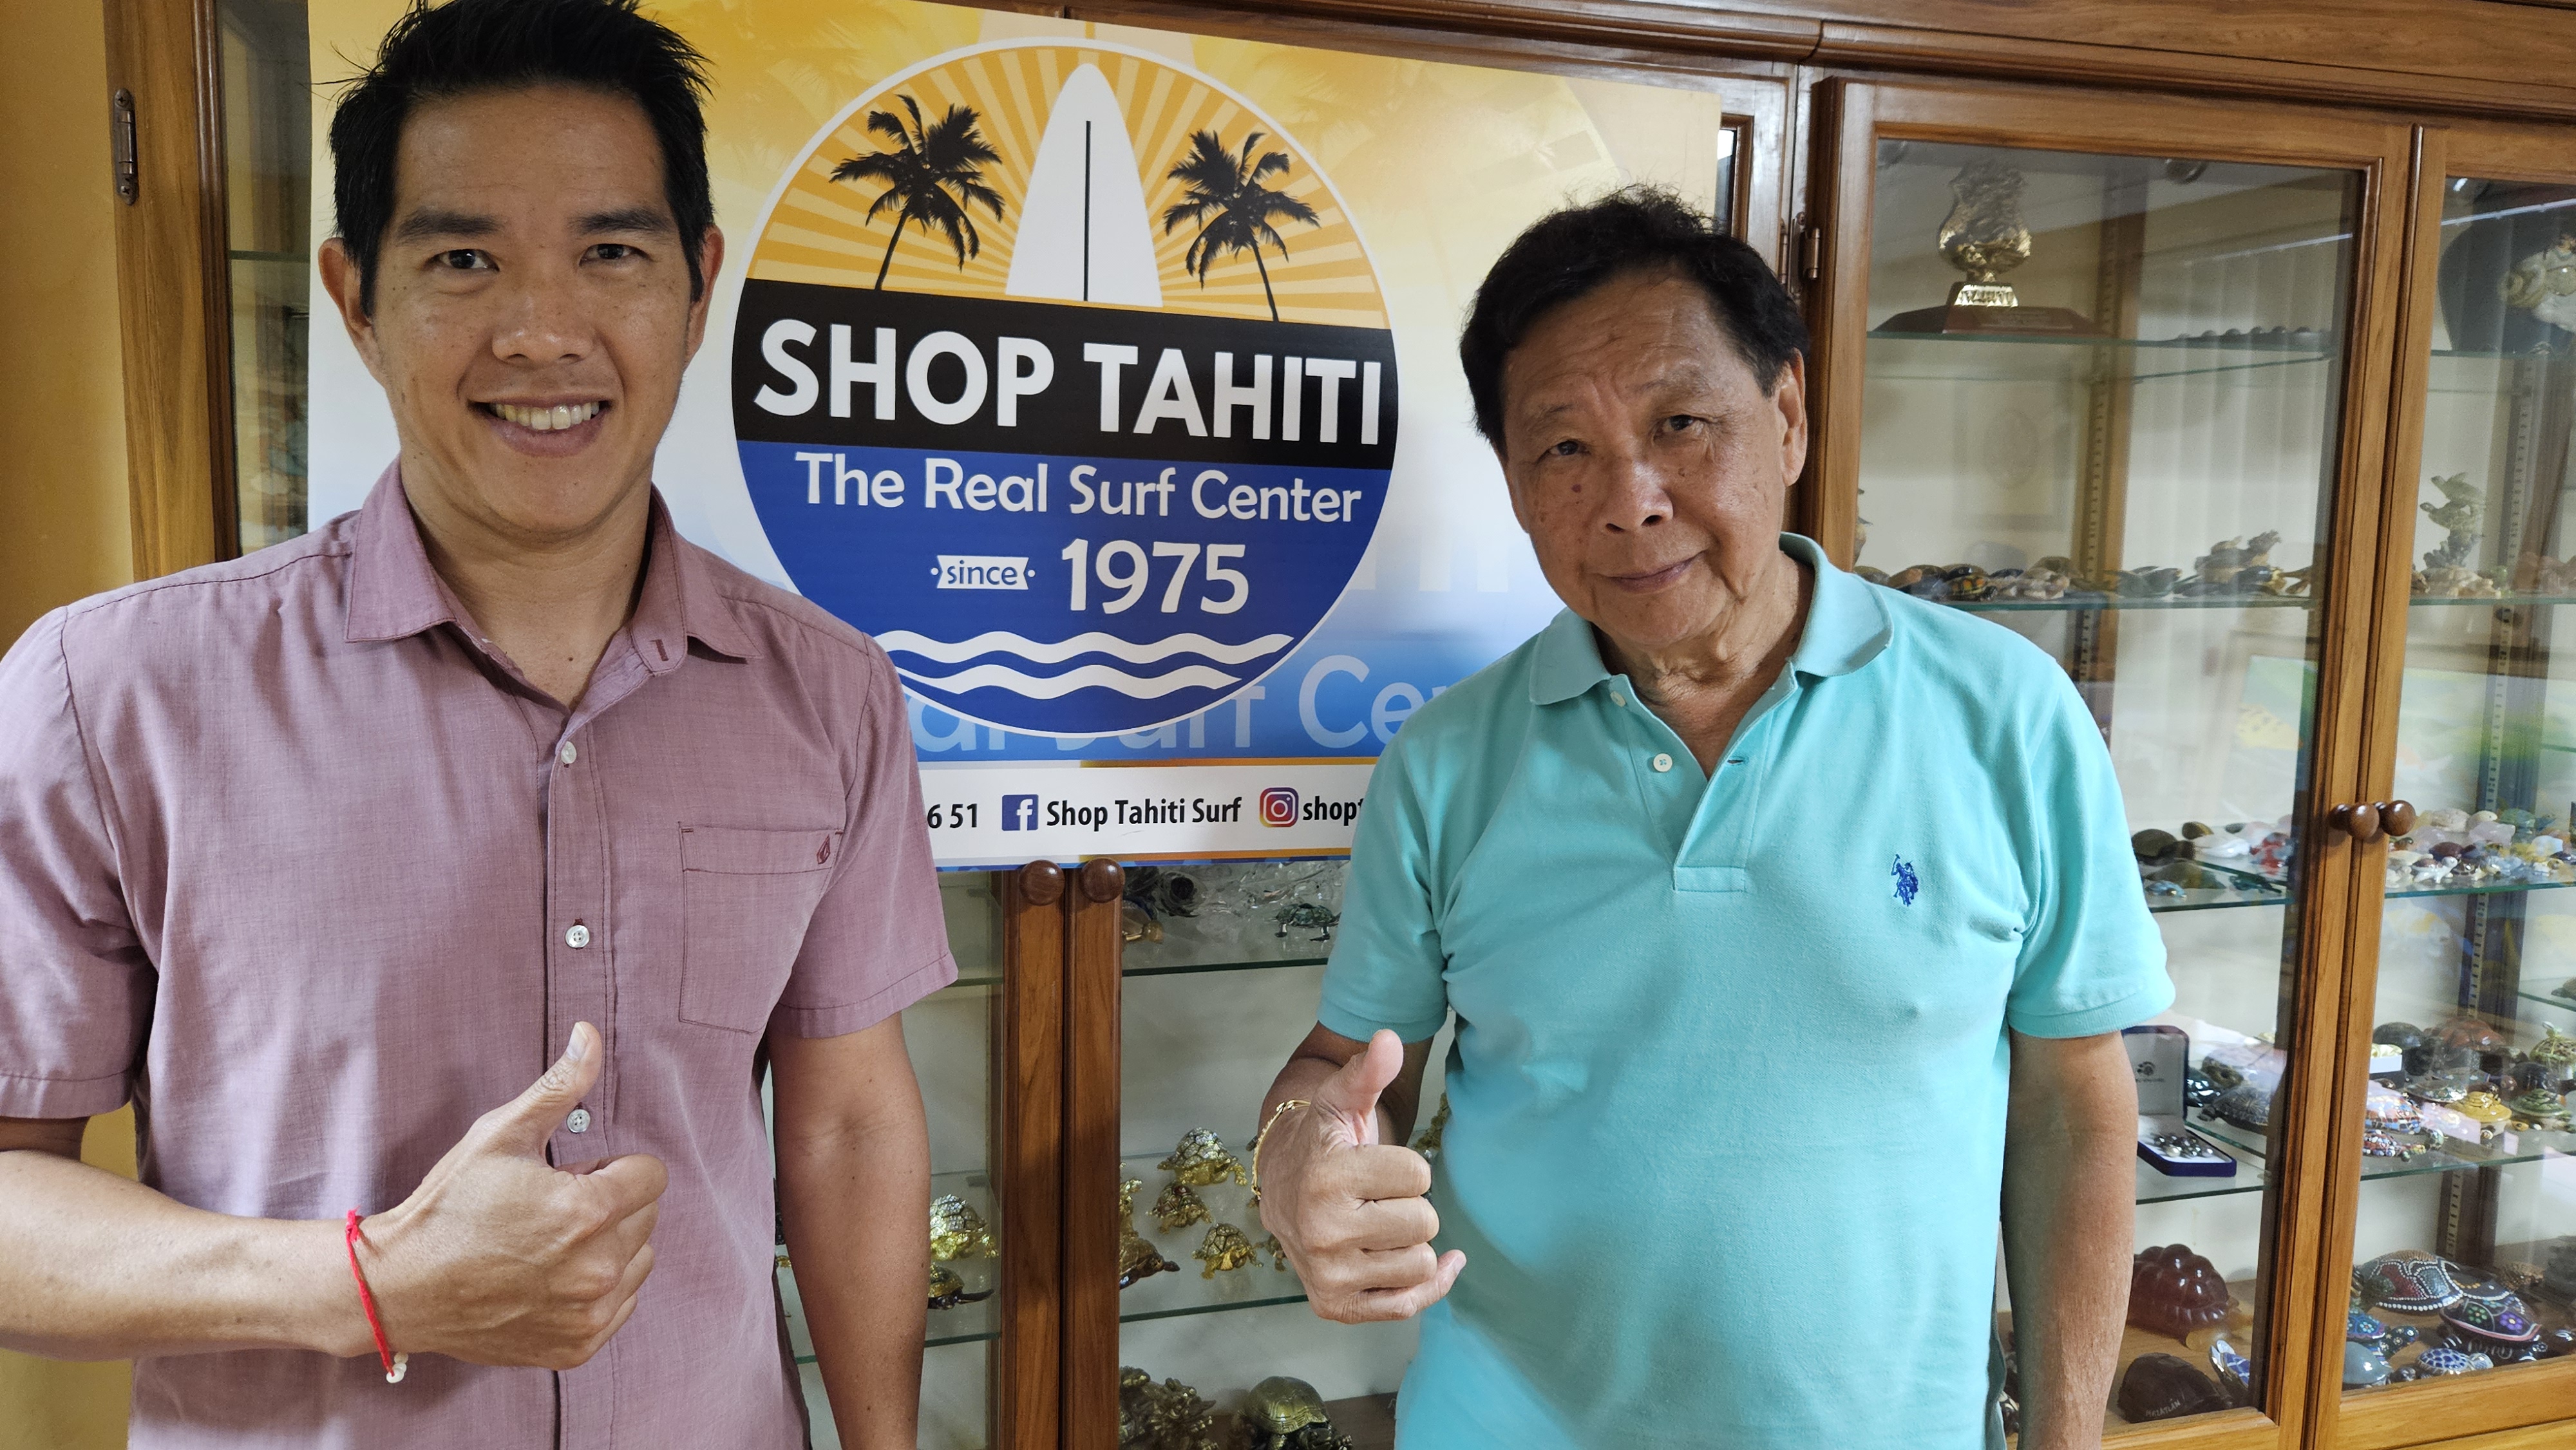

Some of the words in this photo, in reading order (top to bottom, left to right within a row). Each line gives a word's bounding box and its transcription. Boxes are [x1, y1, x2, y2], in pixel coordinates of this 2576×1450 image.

[753, 318, 1055, 427] SHOP
[1083, 342, 1381, 446] TAHITI
[795, 451, 905, 508] The
[924, 457, 1048, 513] Real
[1069, 464, 1176, 516] Surf
[1191, 469, 1362, 522] Center
[946, 560, 1018, 586] since
[1061, 538, 1249, 614] 1975
[949, 804, 977, 829] 51
[1046, 800, 1108, 832] Shop
[1114, 798, 1185, 824] Tahiti
[1192, 796, 1242, 823] Surf
